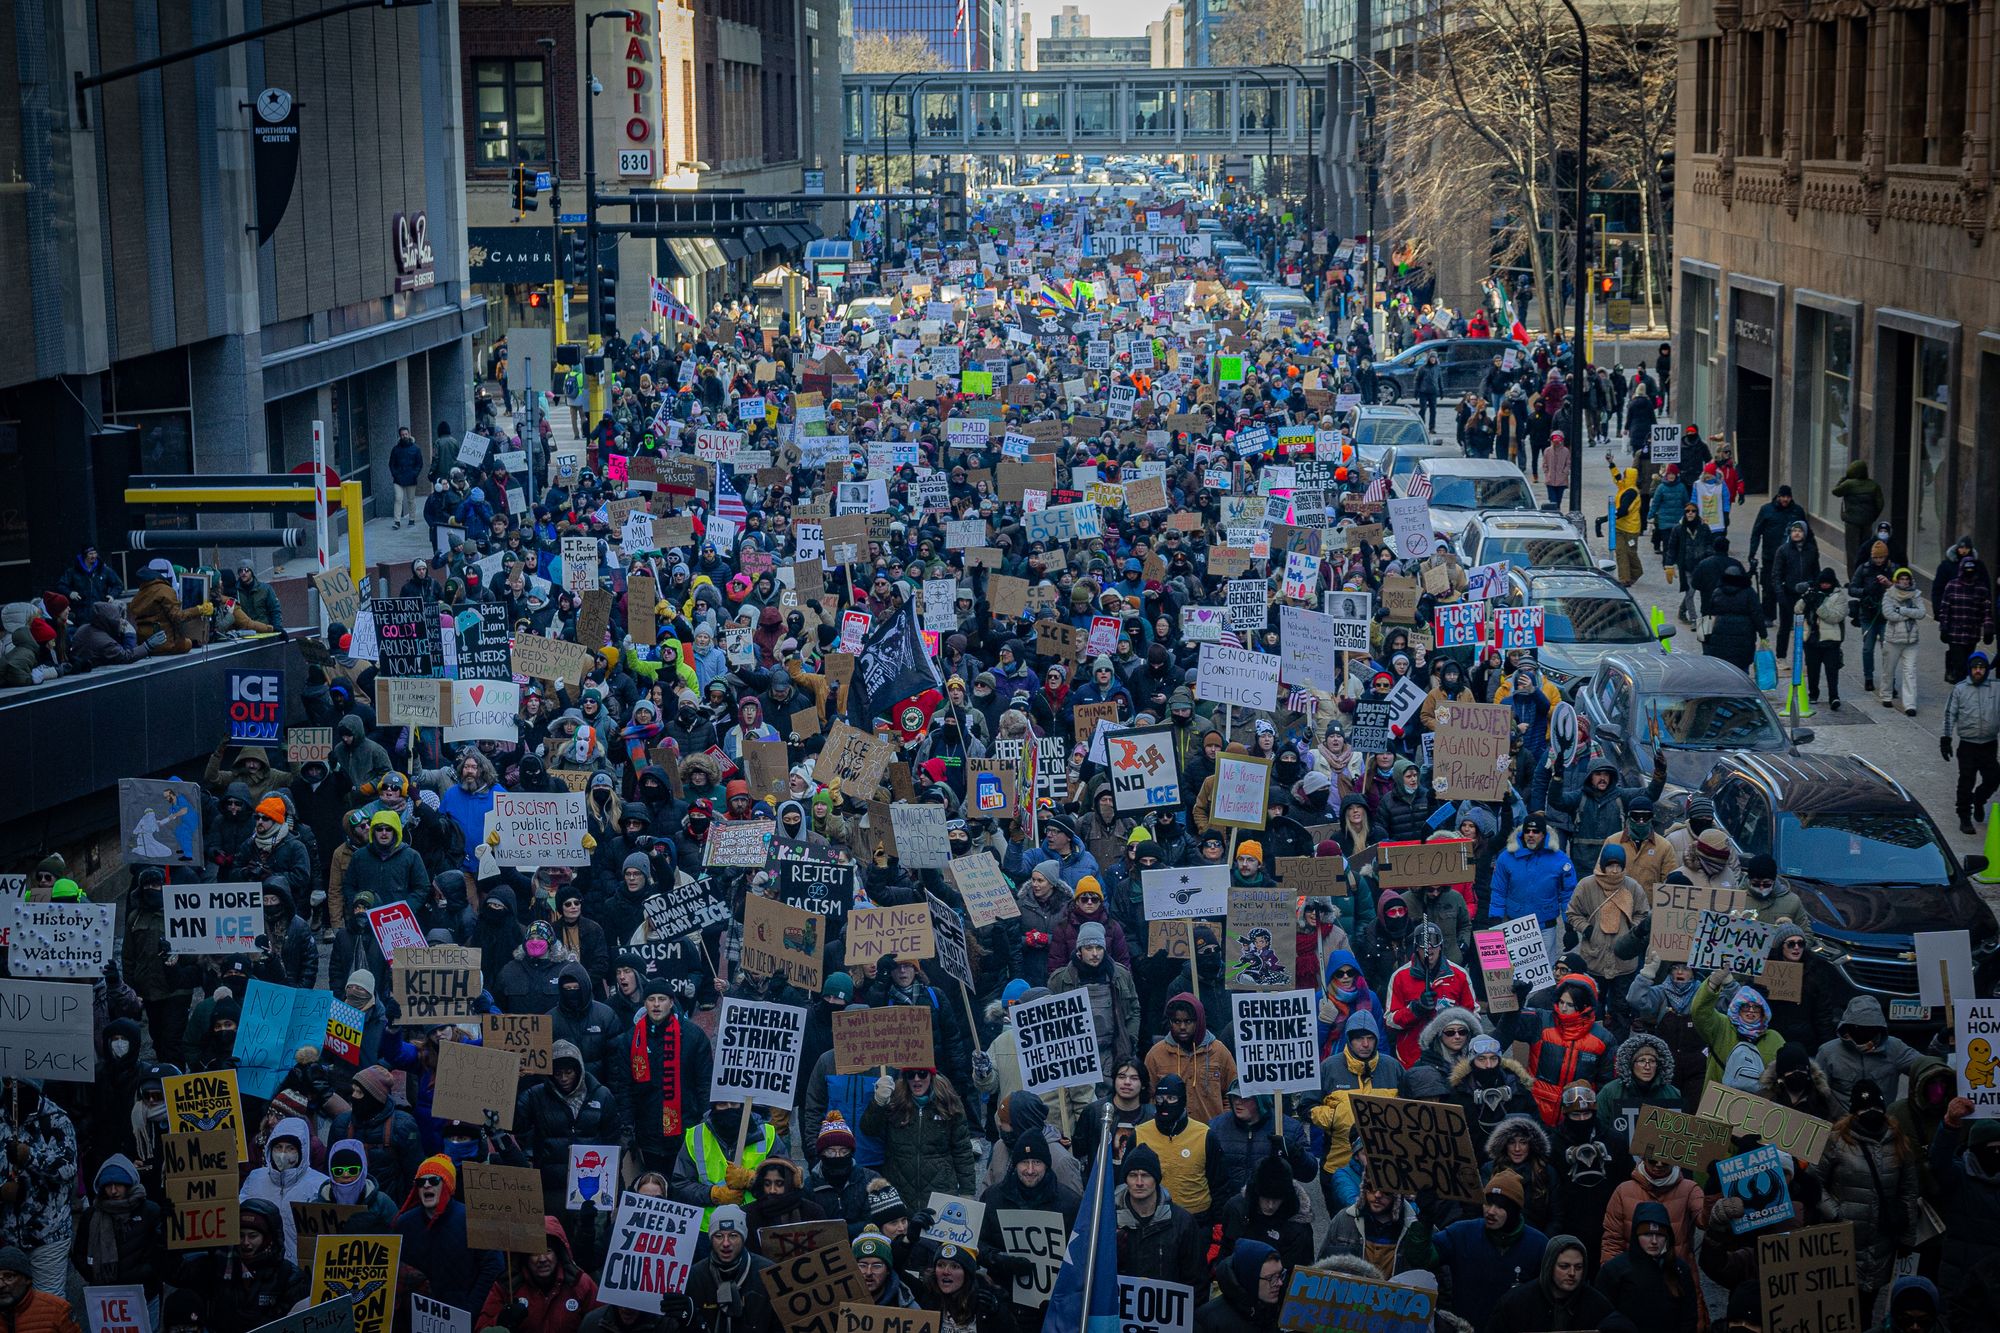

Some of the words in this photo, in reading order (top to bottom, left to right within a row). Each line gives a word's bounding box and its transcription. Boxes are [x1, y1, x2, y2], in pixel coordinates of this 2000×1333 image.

[626, 9, 650, 141] RADIO
[255, 126, 297, 135] NORTHSTAR
[262, 134, 290, 143] CENTER
[1091, 235, 1115, 256] END
[1122, 235, 1142, 256] ICE
[491, 251, 571, 262] CAMBRA
[420, 271, 434, 284] BISTRO
[1112, 386, 1134, 401] STOP
[948, 433, 989, 445] PROTESTER
[1279, 436, 1293, 444] ICE
[1294, 435, 1312, 443] OUT
[1318, 433, 1339, 442] ICE
[1653, 427, 1679, 441] STOP
[1286, 444, 1307, 453] MSP
[1317, 443, 1339, 452] OUT
[1317, 452, 1341, 462] NOW
[1144, 464, 1164, 472] LOVE
[1205, 470, 1222, 478] ICE
[664, 472, 696, 482] FASCISTS
[918, 474, 944, 483] JAIL
[1204, 478, 1219, 486] OUT
[1298, 471, 1331, 480] ARMED
[919, 485, 947, 494] ROSS
[1297, 479, 1334, 489] BULLIES
[1294, 493, 1321, 503] JONATHAN
[795, 506, 809, 514] ICE
[811, 505, 826, 514] LIES
[839, 506, 870, 515] JUSTICE
[1296, 502, 1311, 511] ROSS
[1311, 501, 1323, 509] FOR
[1393, 504, 1427, 516] RELEASE
[1296, 514, 1326, 525] MURDER
[631, 525, 646, 537] MN
[709, 522, 724, 532] MN
[1077, 521, 1097, 536] MN
[564, 539, 574, 551] I
[576, 540, 596, 552] Prefer
[564, 553, 575, 563] My
[575, 552, 597, 563] Country
[573, 570, 586, 580] NO
[570, 579, 595, 590] ICE!
[1228, 582, 1251, 592] EXPAND
[1252, 581, 1266, 590] THE
[1229, 590, 1266, 605] GENERAL
[373, 600, 394, 612] LETS
[396, 600, 419, 611] TURN
[481, 604, 505, 620] Bring
[1231, 605, 1264, 618] STRIKE!
[1282, 606, 1298, 618] Hey
[373, 613, 390, 625] THE
[390, 612, 426, 625] HONMOON
[1499, 611, 1541, 630] FUCK
[382, 624, 418, 638] GOLD!
[482, 621, 505, 632] Liam
[726, 629, 738, 637] ICE
[738, 628, 752, 636] OUT
[482, 631, 510, 645] home!
[1348, 638, 1366, 650] GOOD
[458, 652, 472, 665] HE
[475, 650, 506, 664] NEEDS
[1293, 650, 1325, 664] HATE
[459, 667, 475, 680] HIS
[476, 664, 510, 679] MAMA
[392, 680, 417, 691] THIS
[392, 693, 406, 701] THE
[408, 693, 436, 701] DUMBEST
[486, 691, 513, 705] OUR
[1201, 685, 1262, 706] ETHICS
[396, 704, 438, 718] DYSTOPIA
[1077, 704, 1113, 718] CHINGA
[1355, 703, 1390, 715] ABOLISH
[1450, 705, 1511, 735] PUSSIES
[232, 720, 279, 738] NOW
[1353, 728, 1388, 739] RESIST
[1353, 737, 1387, 750] FACISM
[1439, 736, 1506, 756] AGAINST
[981, 784, 994, 795] ICE
[1235, 784, 1246, 794] OUR
[981, 792, 1003, 808] MELT
[518, 831, 568, 847] CRISIS!
[896, 836, 946, 847] AMERICA
[497, 849, 532, 860] NURSES
[537, 850, 553, 859] FOR
[557, 848, 587, 860] PEACE!
[791, 864, 849, 885] REJECT
[174, 893, 201, 910] NO
[209, 891, 262, 909] MORE
[645, 896, 666, 916] NO
[667, 876, 712, 905] DECENT
[1176, 909, 1191, 917] AND
[1705, 913, 1730, 927] NO
[33, 912, 93, 929] History
[854, 911, 885, 931] MN
[890, 910, 926, 929] Nice
[54, 929, 66, 943] is
[875, 928, 906, 937] NOT
[391, 940, 402, 949] OUT
[404, 937, 411, 945] OF
[852, 939, 887, 957] MN
[890, 935, 921, 953] ICE
[23, 948, 102, 963] Watching
[406, 948, 469, 966] REMEMBER
[405, 968, 469, 998] KEITH
[40, 994, 78, 1023] UP
[1016, 995, 1087, 1028] GENERAL
[1969, 1007, 1994, 1019] ALL
[491, 1016, 540, 1032] BITCH
[1019, 1014, 1091, 1048] STRIKE:
[504, 1031, 530, 1046] ASS
[722, 1026, 799, 1053] STRIKE:
[1241, 1044, 1264, 1062] THE
[1267, 1042, 1295, 1061] PATH
[1298, 1040, 1314, 1058] TO
[1027, 1054, 1097, 1086] JUSTICE
[174, 1076, 230, 1101] LEAVE
[175, 1098, 232, 1113] MINNESOTA
[1645, 1109, 1730, 1146] ABOLISH
[171, 1207, 226, 1242] NICE
[626, 1212, 687, 1235] NEEDS
[620, 1228, 677, 1257] YOUR
[325, 1239, 389, 1266] LEAVE
[324, 1265, 388, 1280] MINNESOTA
[604, 1252, 688, 1295] COURAGE
[1767, 1272, 1799, 1299] BUT
[1804, 1265, 1856, 1292] STILL
[1288, 1270, 1431, 1319] MINNESOTA
[1137, 1284, 1189, 1326] OUT
